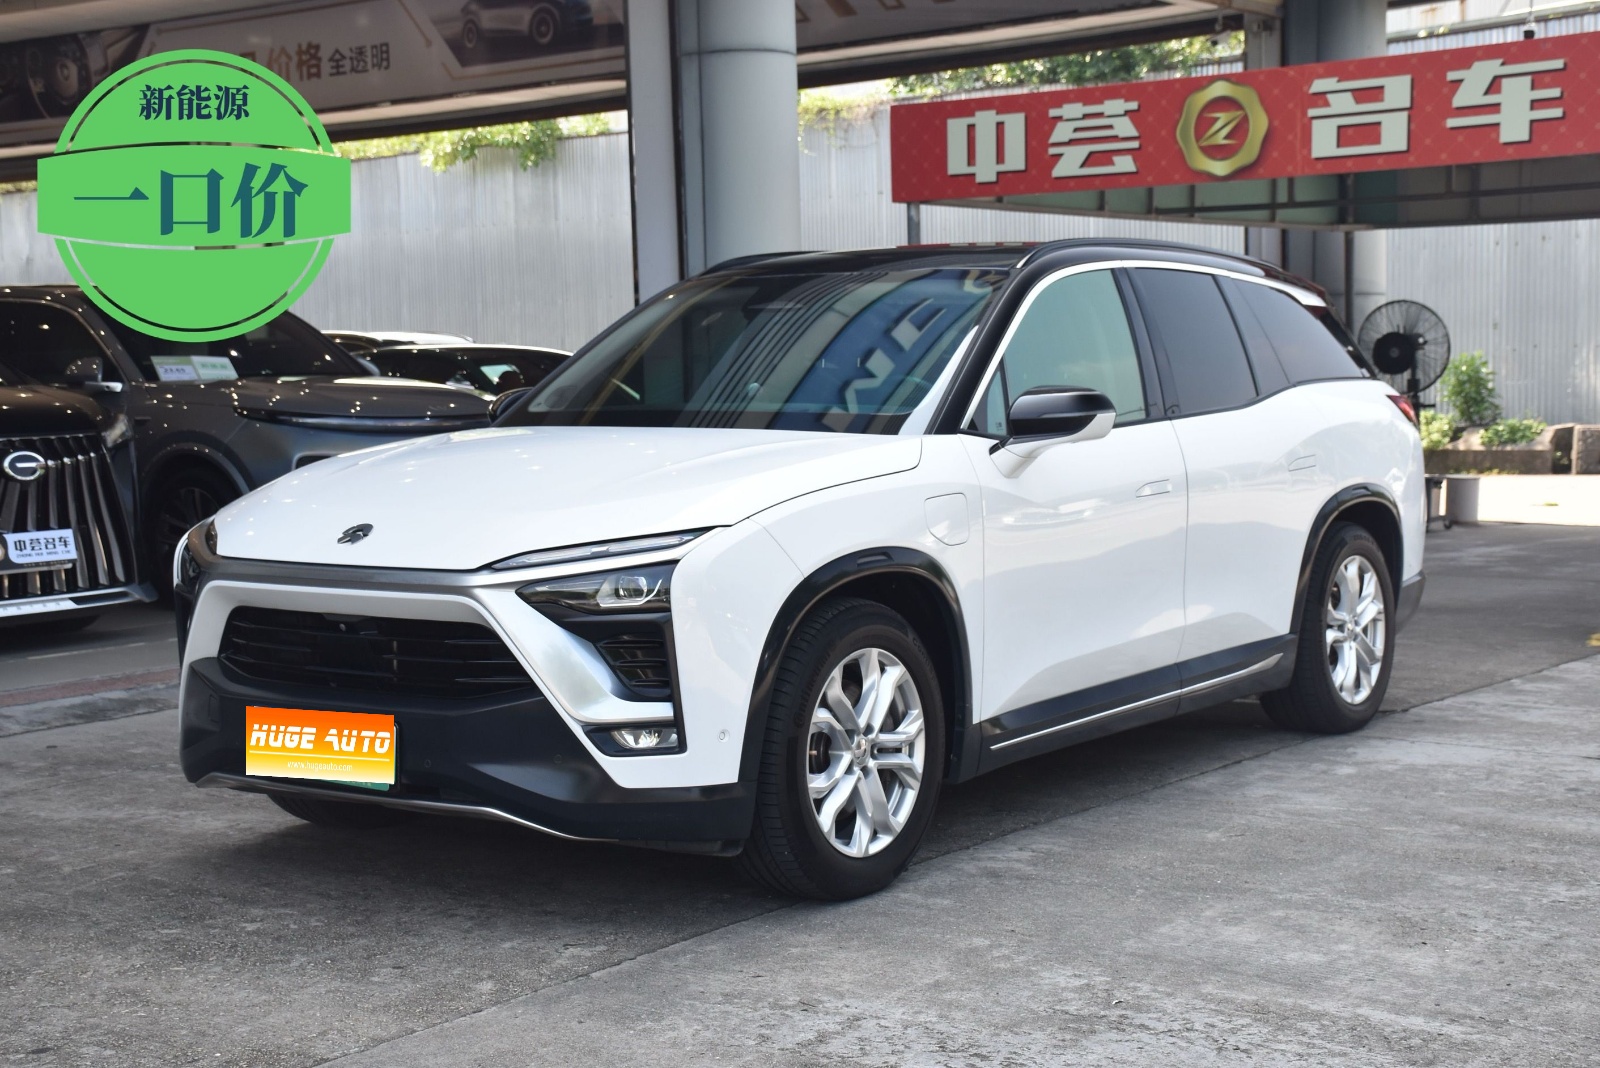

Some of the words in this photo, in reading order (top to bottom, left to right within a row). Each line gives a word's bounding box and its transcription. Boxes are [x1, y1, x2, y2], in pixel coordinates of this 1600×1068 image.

[327, 42, 391, 78] 全透明
[1307, 58, 1566, 160] 名车
[14, 535, 71, 552] 中荟名车
